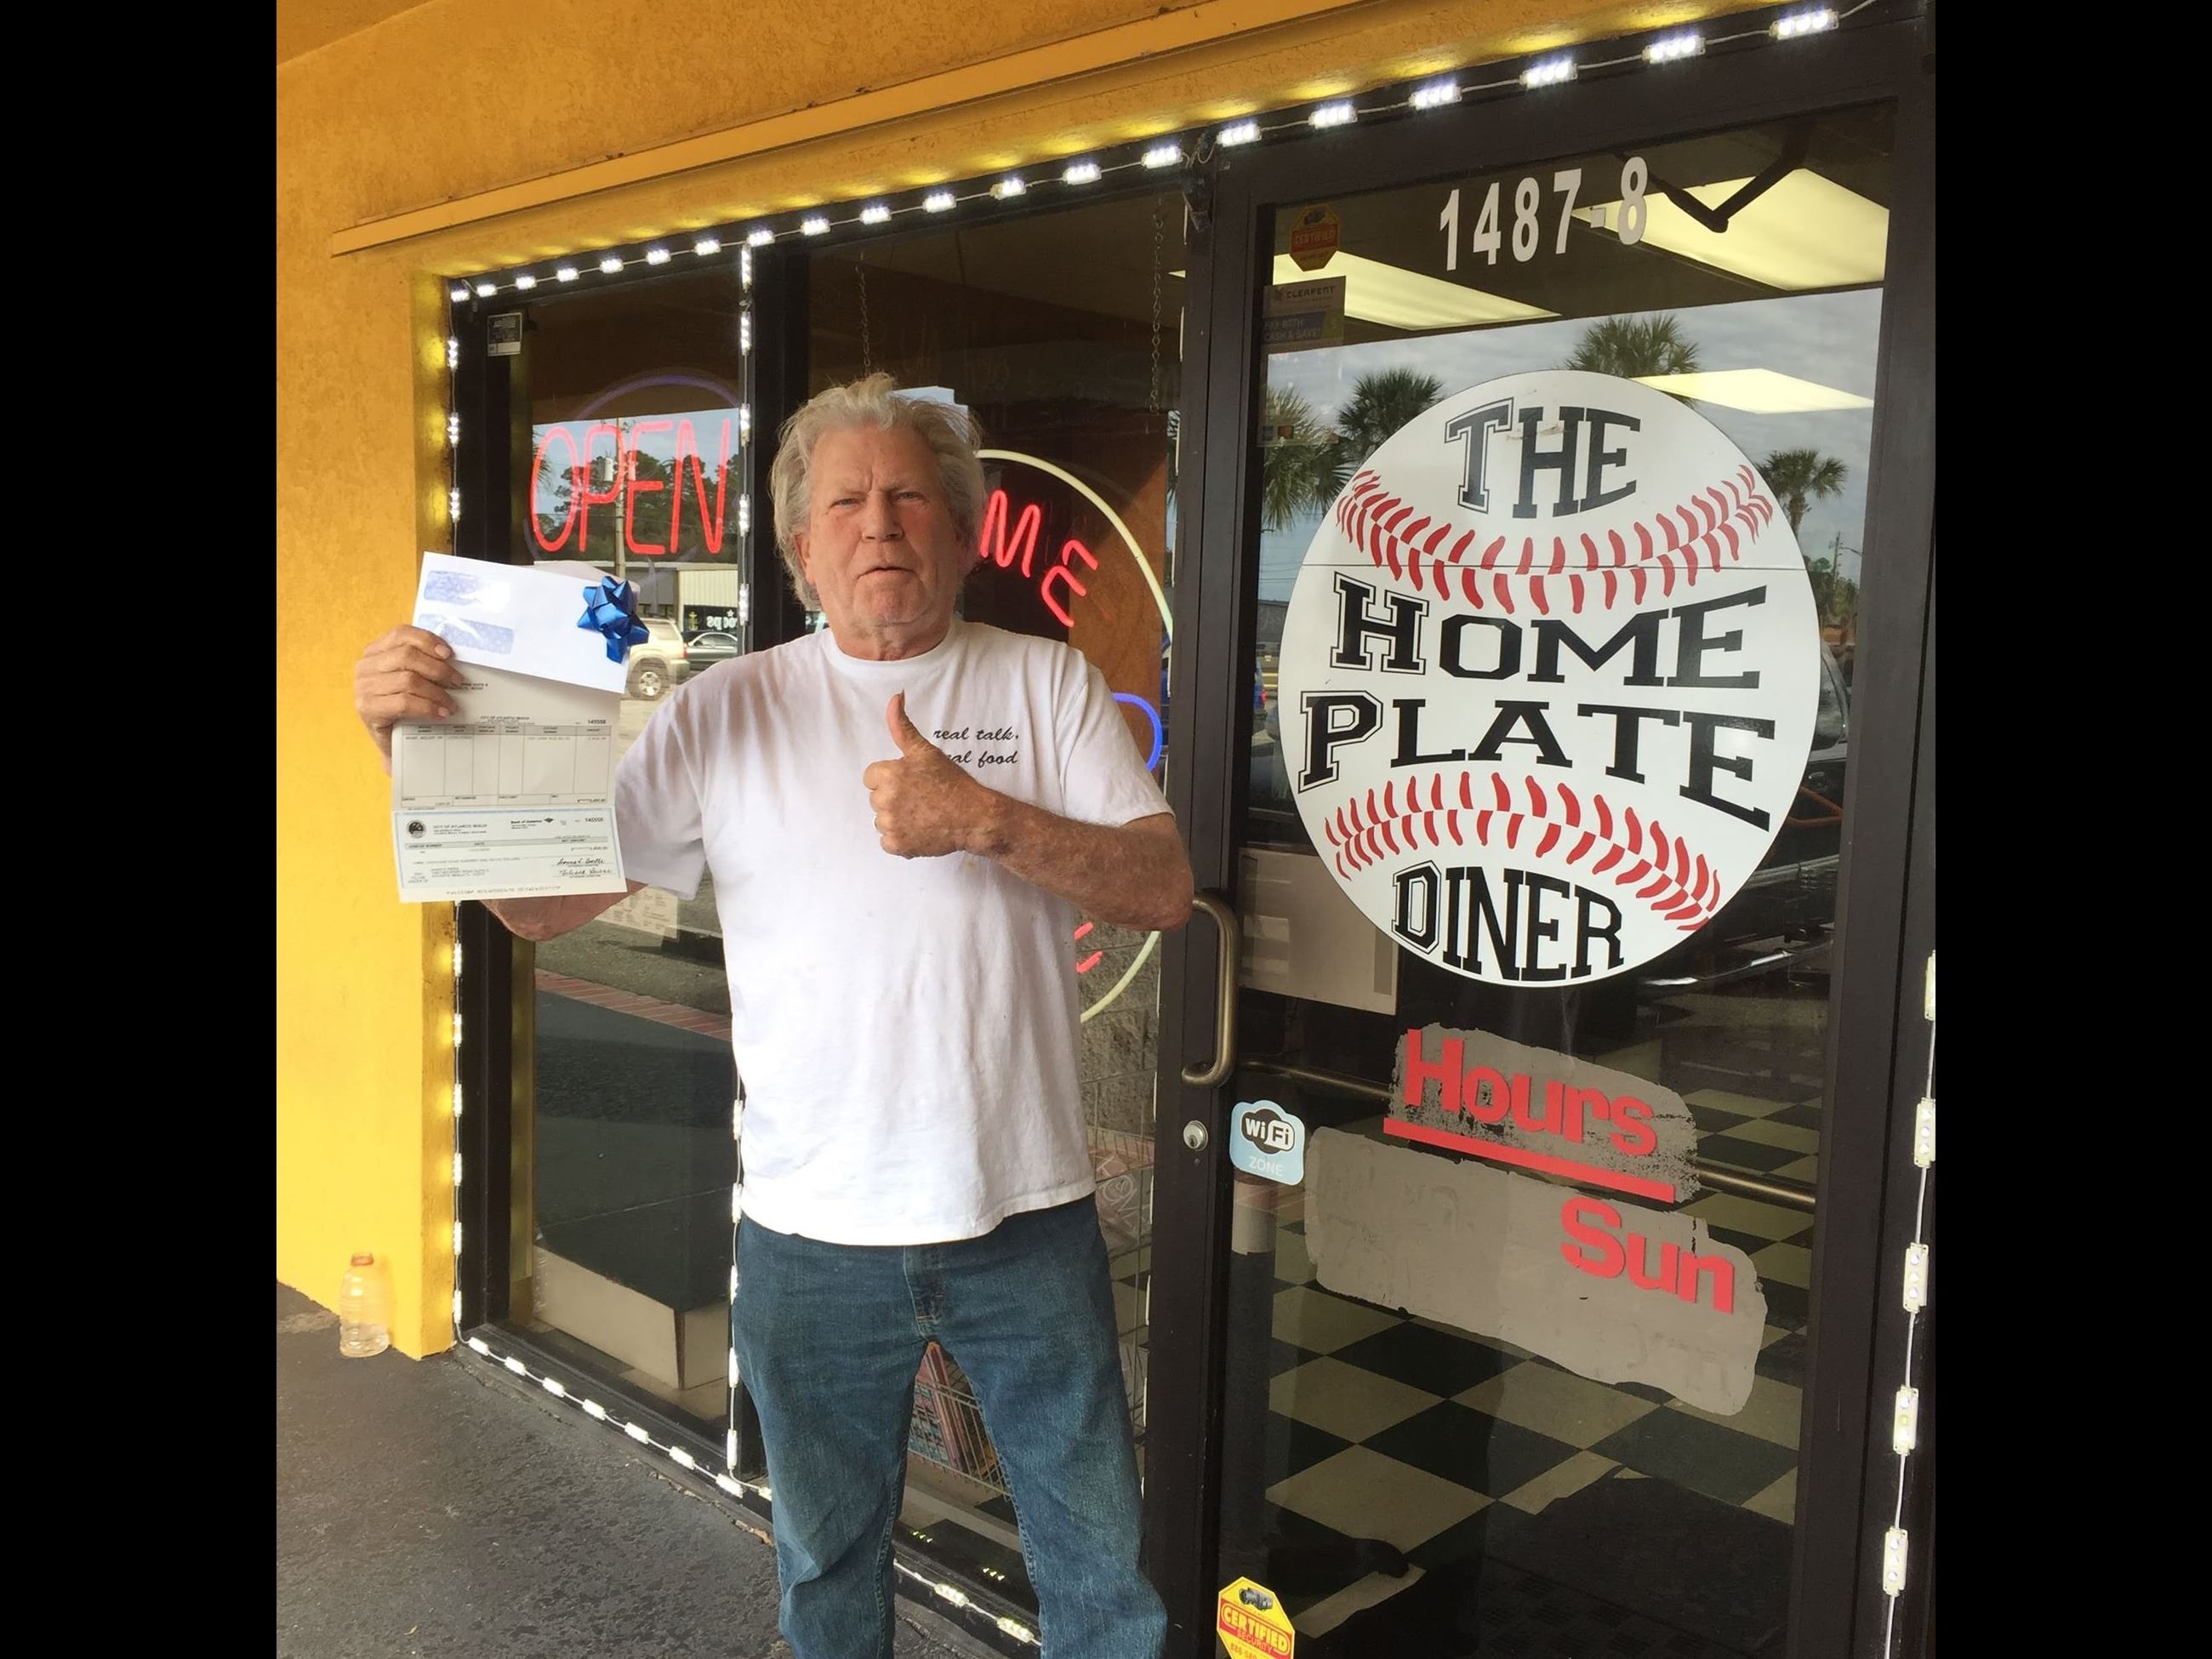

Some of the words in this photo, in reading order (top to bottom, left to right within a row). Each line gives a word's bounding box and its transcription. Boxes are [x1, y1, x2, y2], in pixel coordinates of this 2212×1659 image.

[1440, 157, 1648, 271] 1487-8
[530, 418, 732, 555] OPEN
[1444, 397, 1641, 519] THE
[1330, 571, 1768, 690] HOME
[933, 727, 970, 741] real
[976, 726, 1019, 741] talk.
[978, 750, 1018, 768] food
[1297, 690, 1776, 833] PLATE
[1391, 860, 1625, 982] DINER
[1402, 1029, 1658, 1158] Hours
[1248, 1155, 1285, 1177] ZONE
[1560, 1197, 1735, 1314] Sun
[1223, 1605, 1289, 1654] CERTIFIED
[1236, 1628, 1274, 1653] SECURITY
